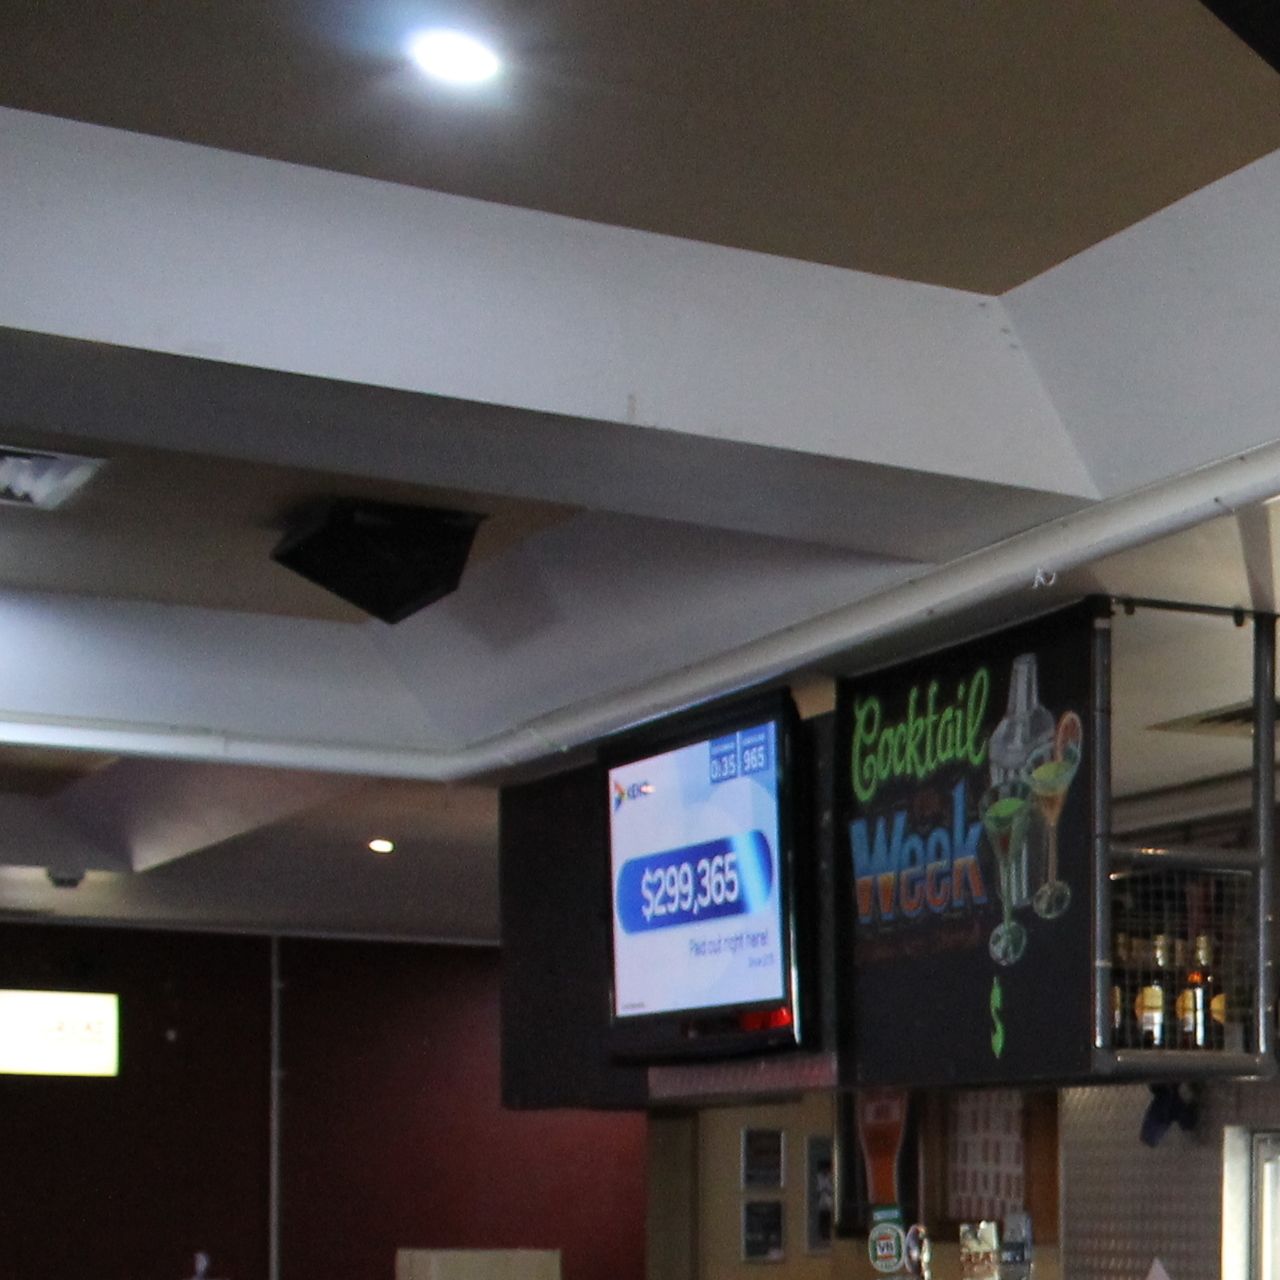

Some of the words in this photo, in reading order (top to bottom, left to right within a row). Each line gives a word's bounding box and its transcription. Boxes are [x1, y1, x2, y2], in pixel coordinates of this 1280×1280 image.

[852, 666, 990, 802] Cocktail
[641, 852, 739, 922] $299,365
[850, 778, 989, 925] Week
